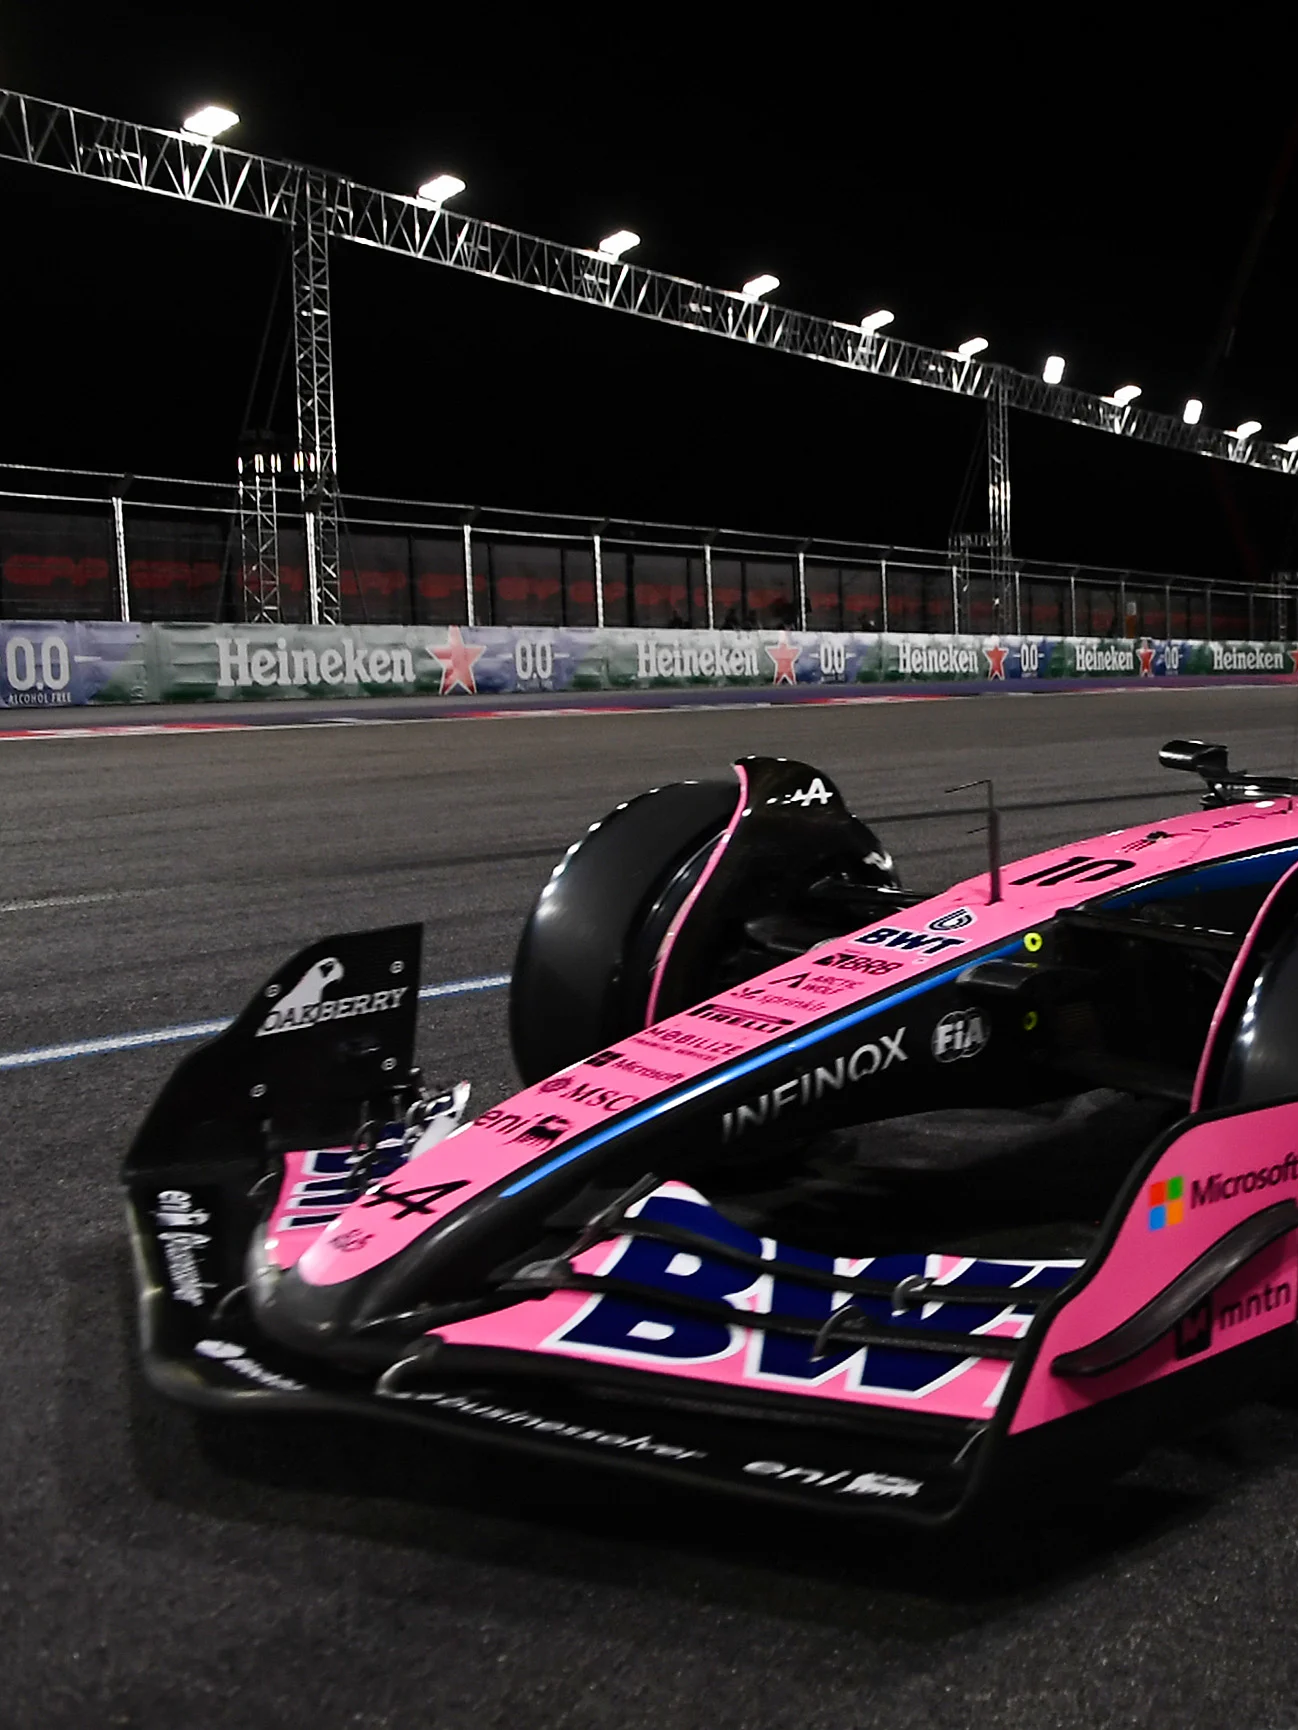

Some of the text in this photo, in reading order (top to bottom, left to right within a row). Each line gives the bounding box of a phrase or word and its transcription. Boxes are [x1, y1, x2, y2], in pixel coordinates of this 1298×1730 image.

[6, 636, 71, 691] 0.0
[216, 637, 417, 687] Heineken
[515, 639, 552, 681] 0.0
[636, 639, 760, 678] Heineken
[819, 644, 844, 674] 0.0
[899, 643, 979, 673] Heineken
[1075, 644, 1135, 671] Heineken
[1213, 647, 1285, 670] Heineken
[853, 927, 968, 956] BWT
[257, 987, 409, 1035] OAKBERRY
[686, 1003, 796, 1034] PIRELLI
[643, 1026, 746, 1056] MOBILIZE
[610, 1058, 686, 1084] Microsoft
[559, 1082, 641, 1112] MSC
[473, 1109, 544, 1135] eni
[1218, 1282, 1291, 1331] mntn
